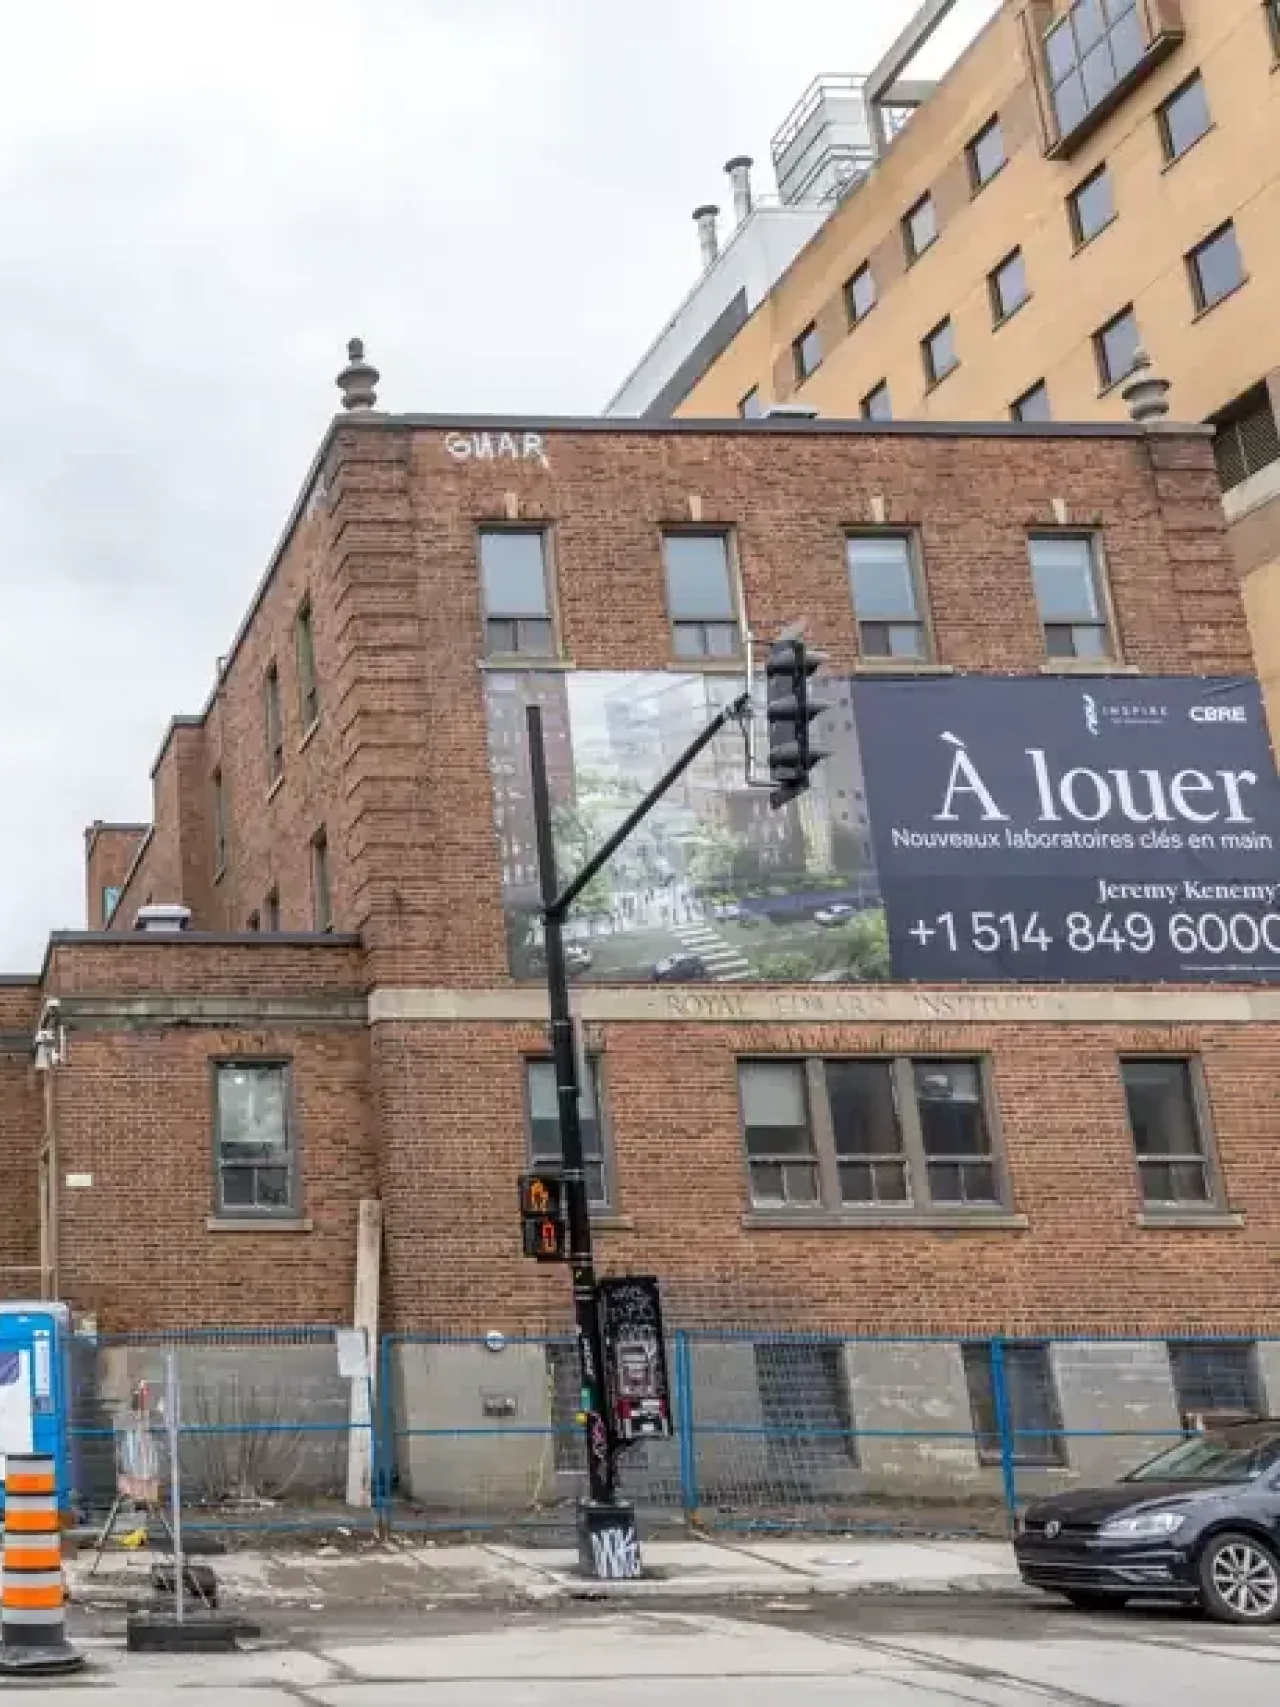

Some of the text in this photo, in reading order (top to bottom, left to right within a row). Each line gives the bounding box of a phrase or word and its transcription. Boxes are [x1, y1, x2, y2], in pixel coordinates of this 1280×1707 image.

[1188, 705, 1248, 722] CBRE
[932, 730, 1259, 824] À louer
[891, 826, 1273, 850] Nouveaux laboratoires clés en main
[1098, 879, 1179, 904] Jeremy
[907, 910, 958, 952] +1
[970, 911, 1054, 953] 514
[1065, 911, 1155, 953] 849
[666, 993, 751, 1017] ROYAL
